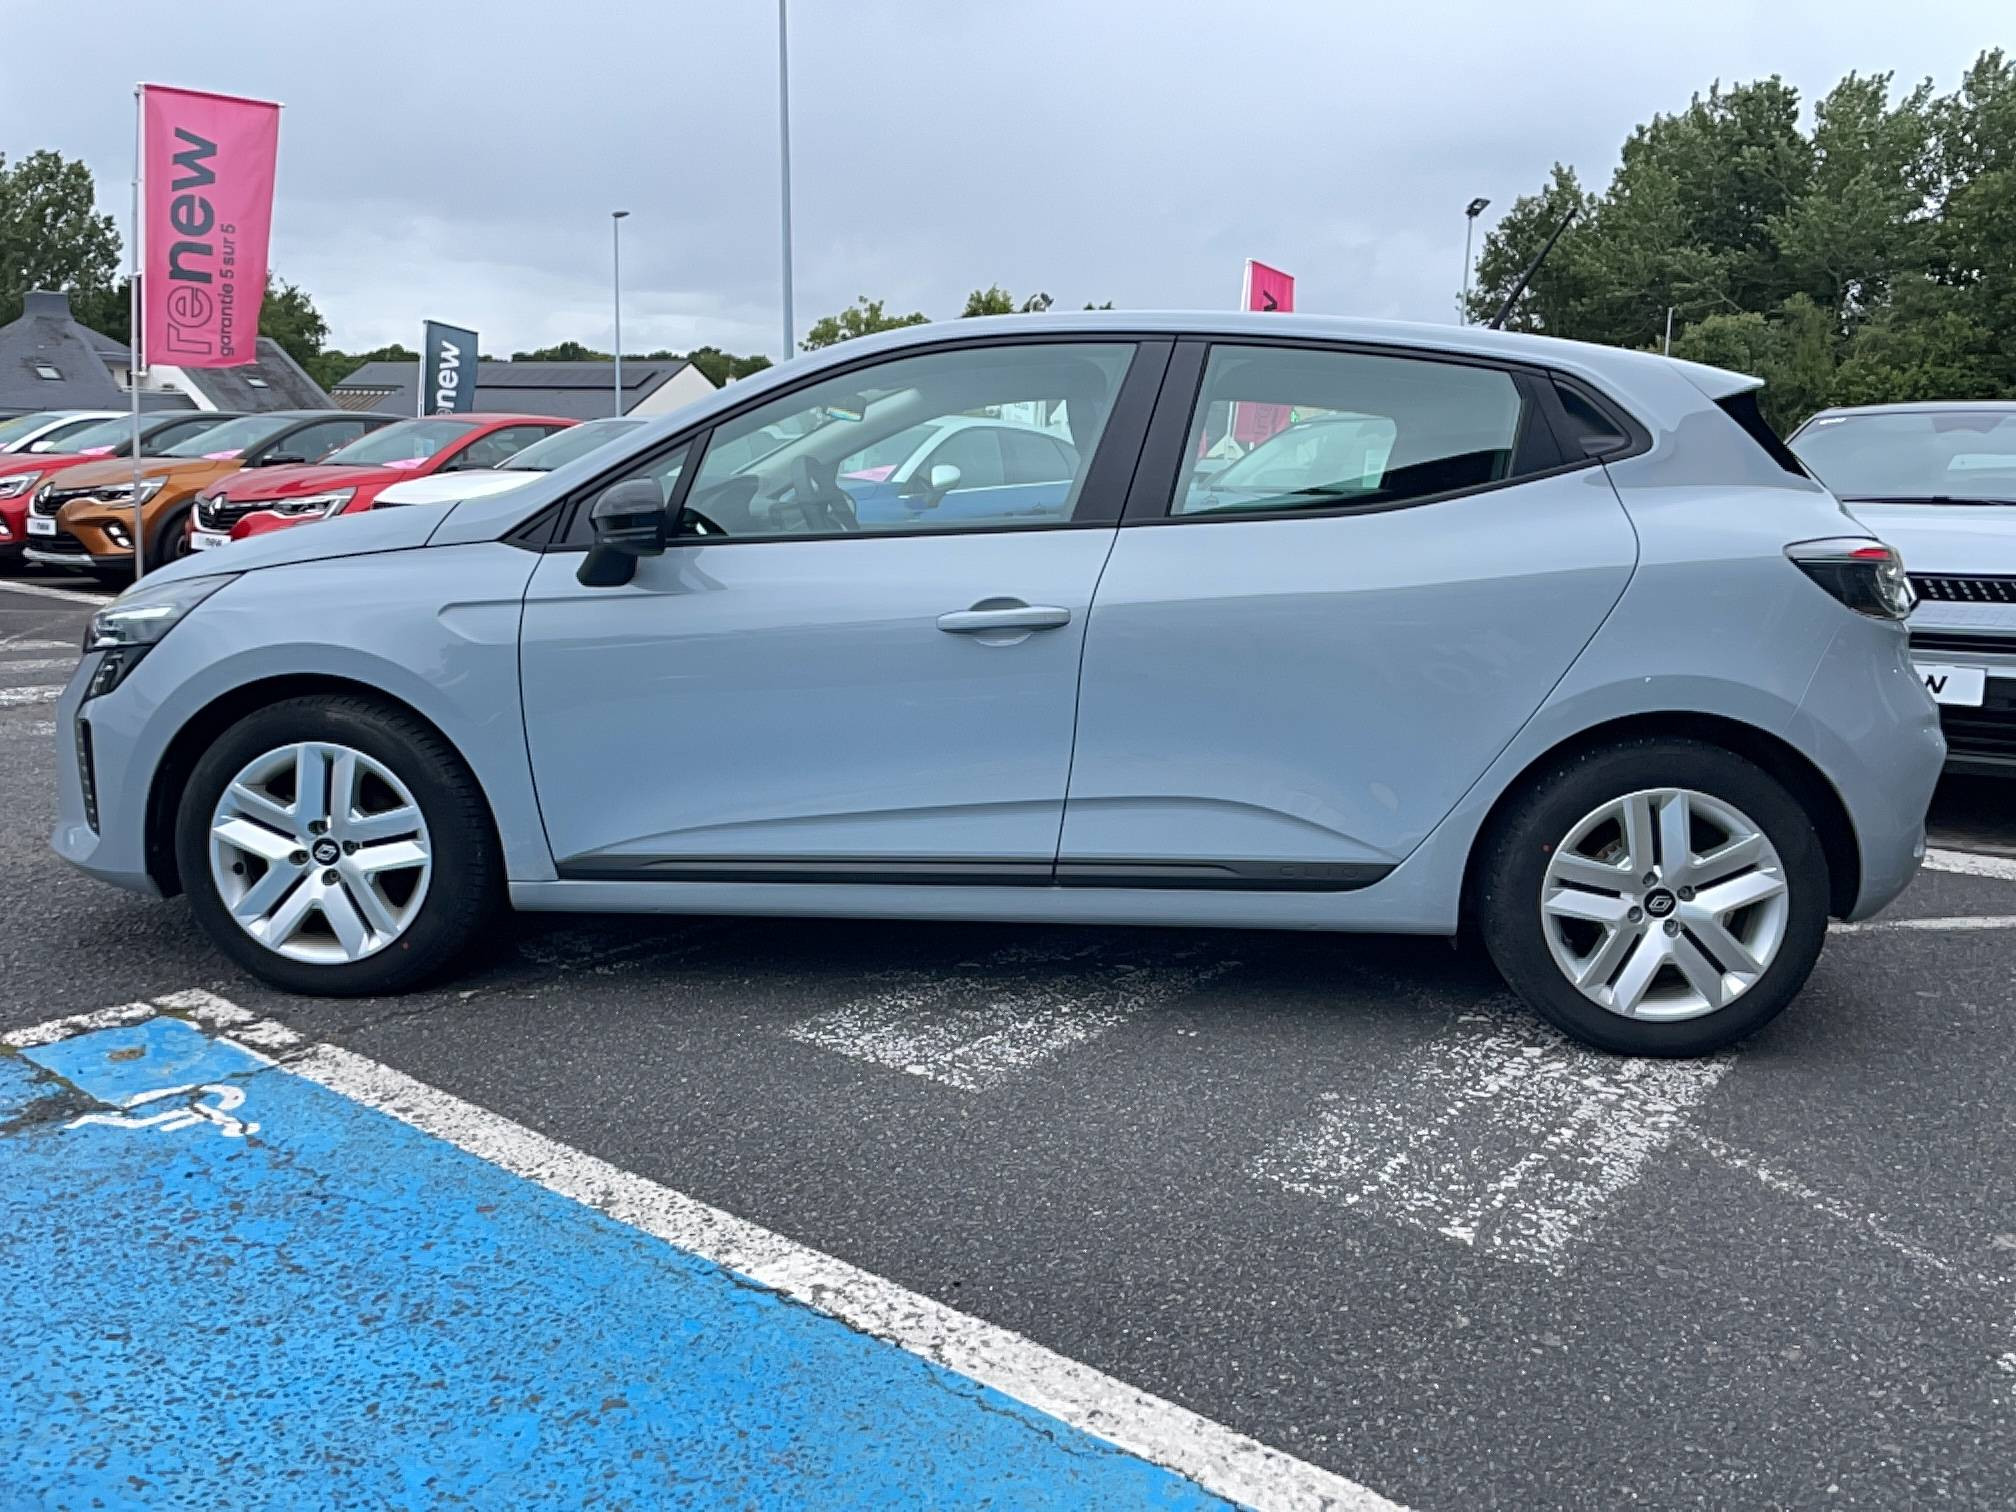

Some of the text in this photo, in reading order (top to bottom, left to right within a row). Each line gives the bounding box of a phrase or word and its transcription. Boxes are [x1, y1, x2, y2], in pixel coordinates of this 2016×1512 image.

[167, 127, 218, 355] renew
[219, 224, 235, 357] garantie 5 sur 5
